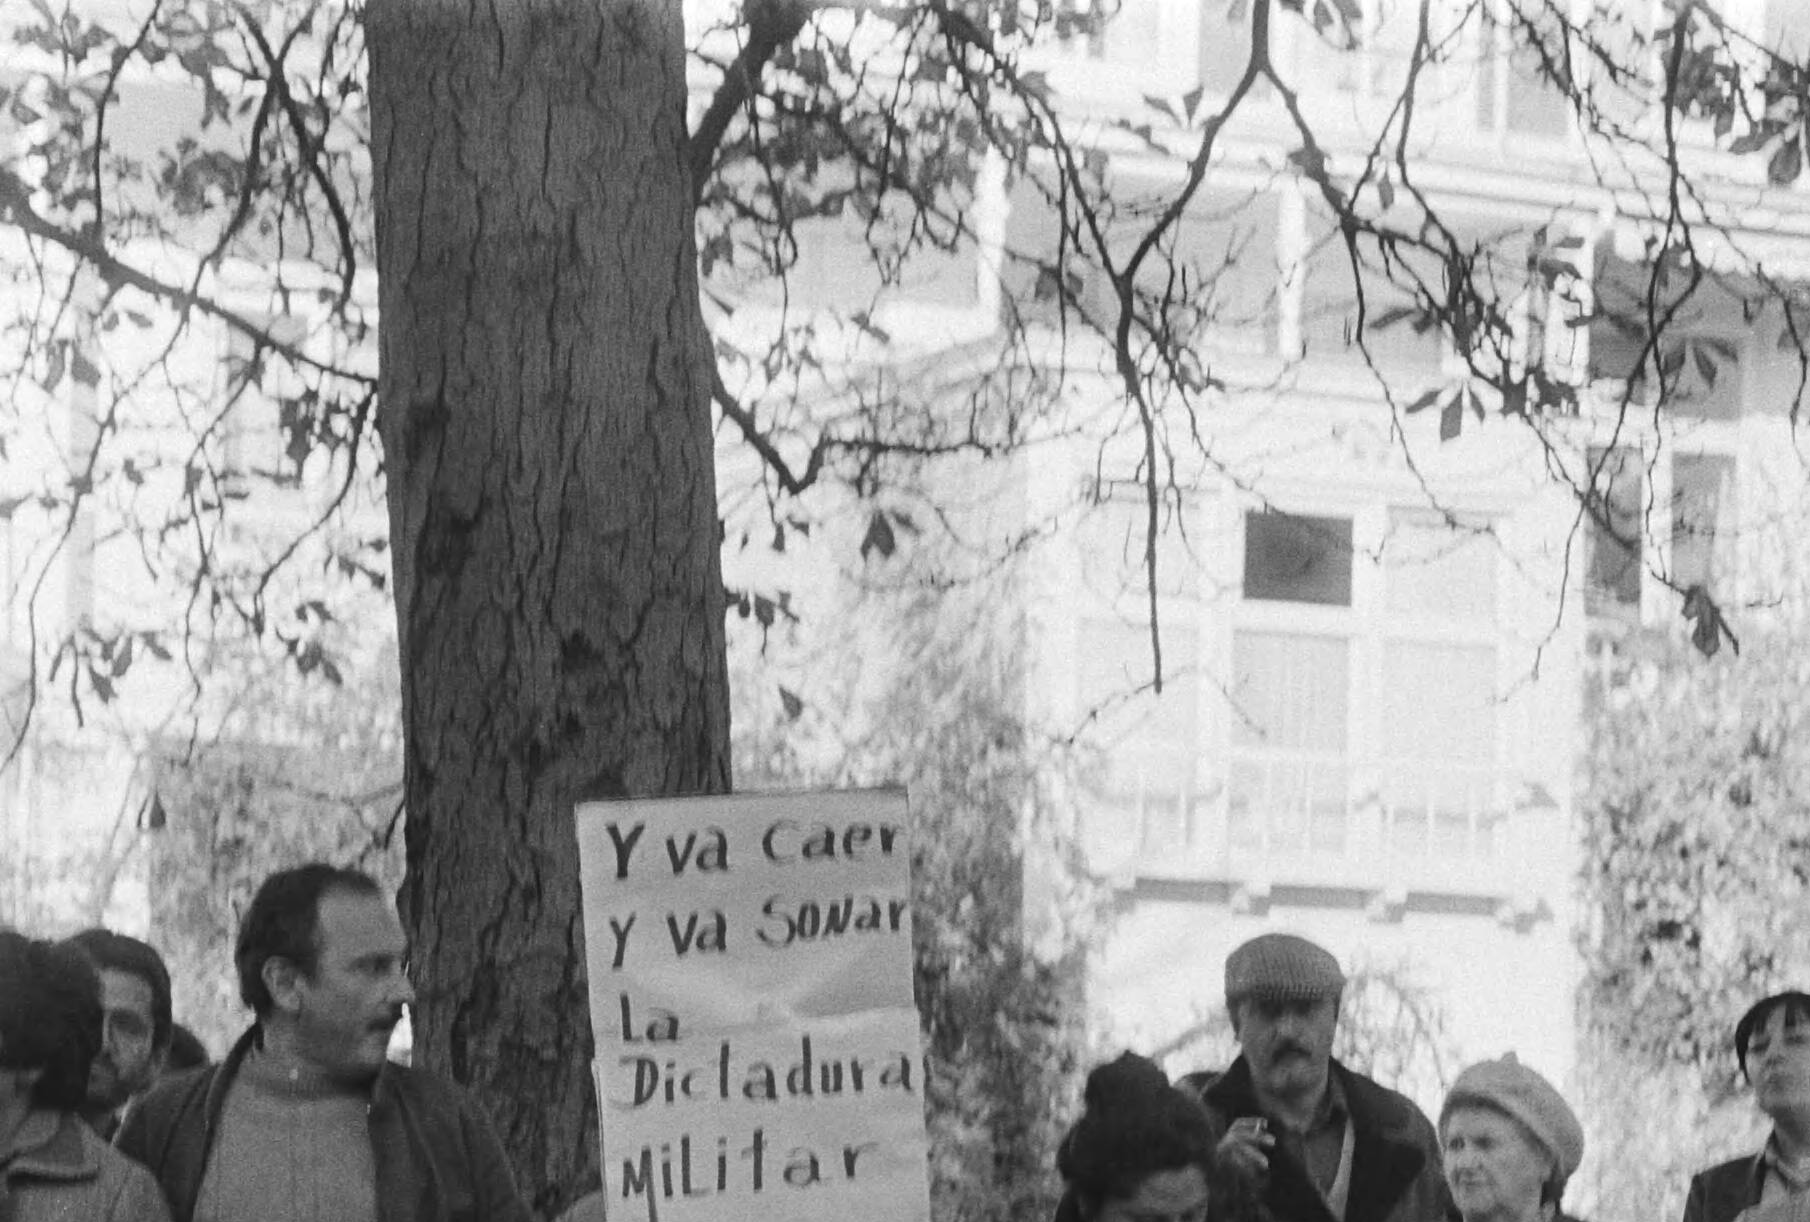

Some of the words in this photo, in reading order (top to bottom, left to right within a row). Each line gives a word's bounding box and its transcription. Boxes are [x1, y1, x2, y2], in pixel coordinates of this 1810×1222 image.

[606, 822, 645, 879] Y
[666, 826, 729, 877] va
[620, 991, 679, 1043] La
[618, 1033, 914, 1110] Dictadura
